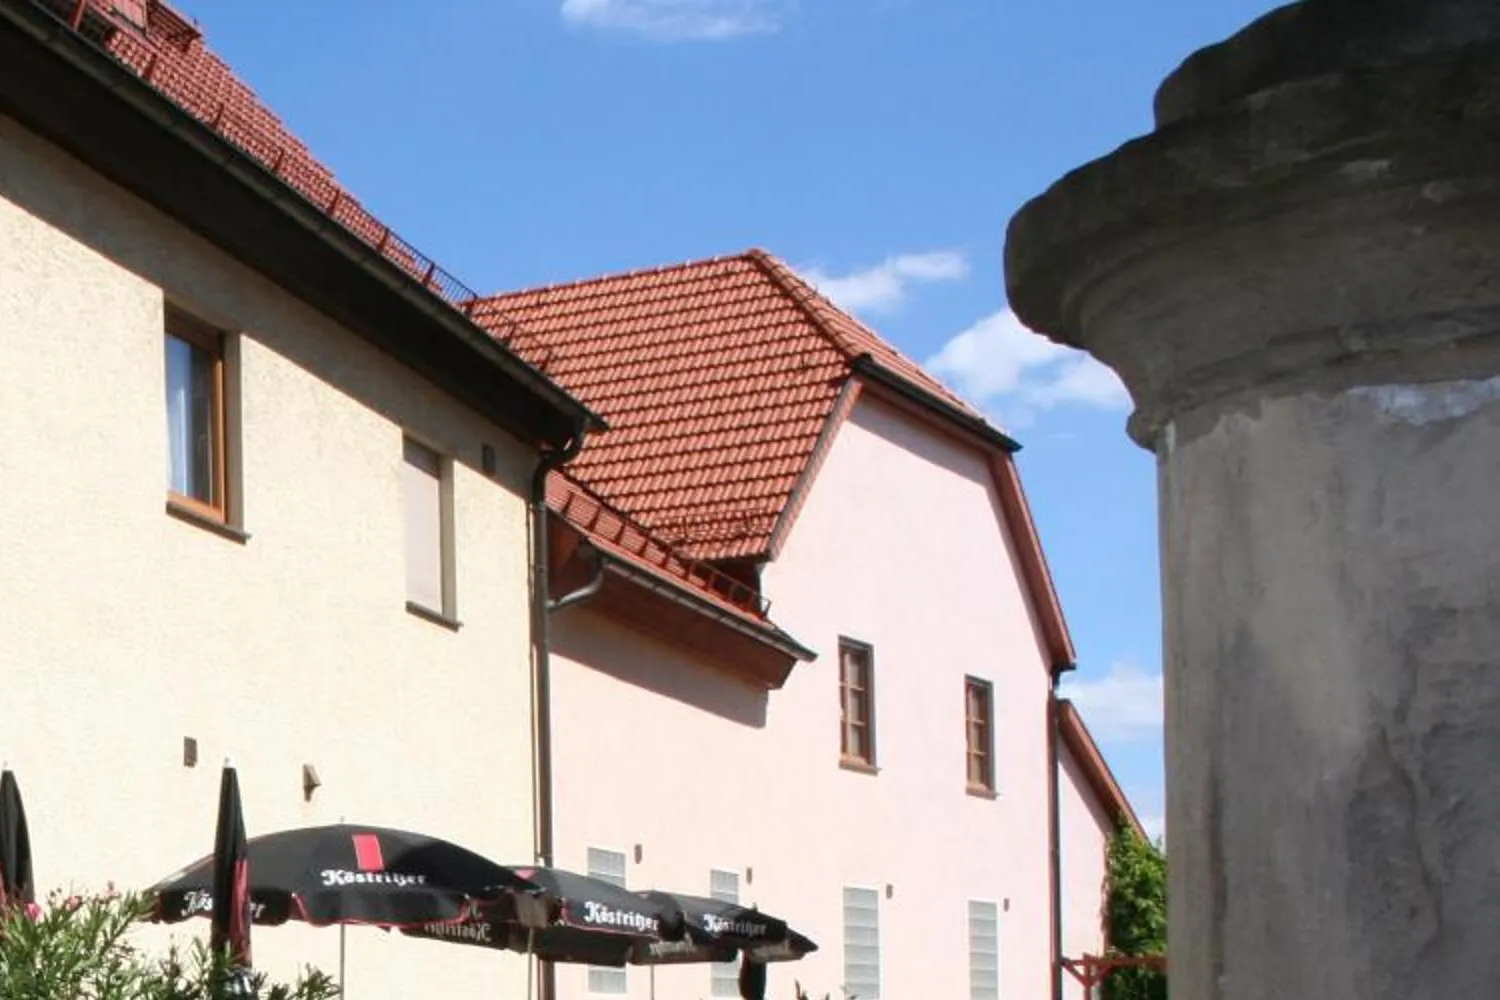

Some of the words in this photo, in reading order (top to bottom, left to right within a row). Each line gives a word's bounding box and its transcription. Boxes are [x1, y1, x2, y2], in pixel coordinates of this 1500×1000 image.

[321, 868, 427, 887] Köstritzer
[583, 900, 659, 932] Köstritzer
[702, 912, 768, 937] Köstritzer
